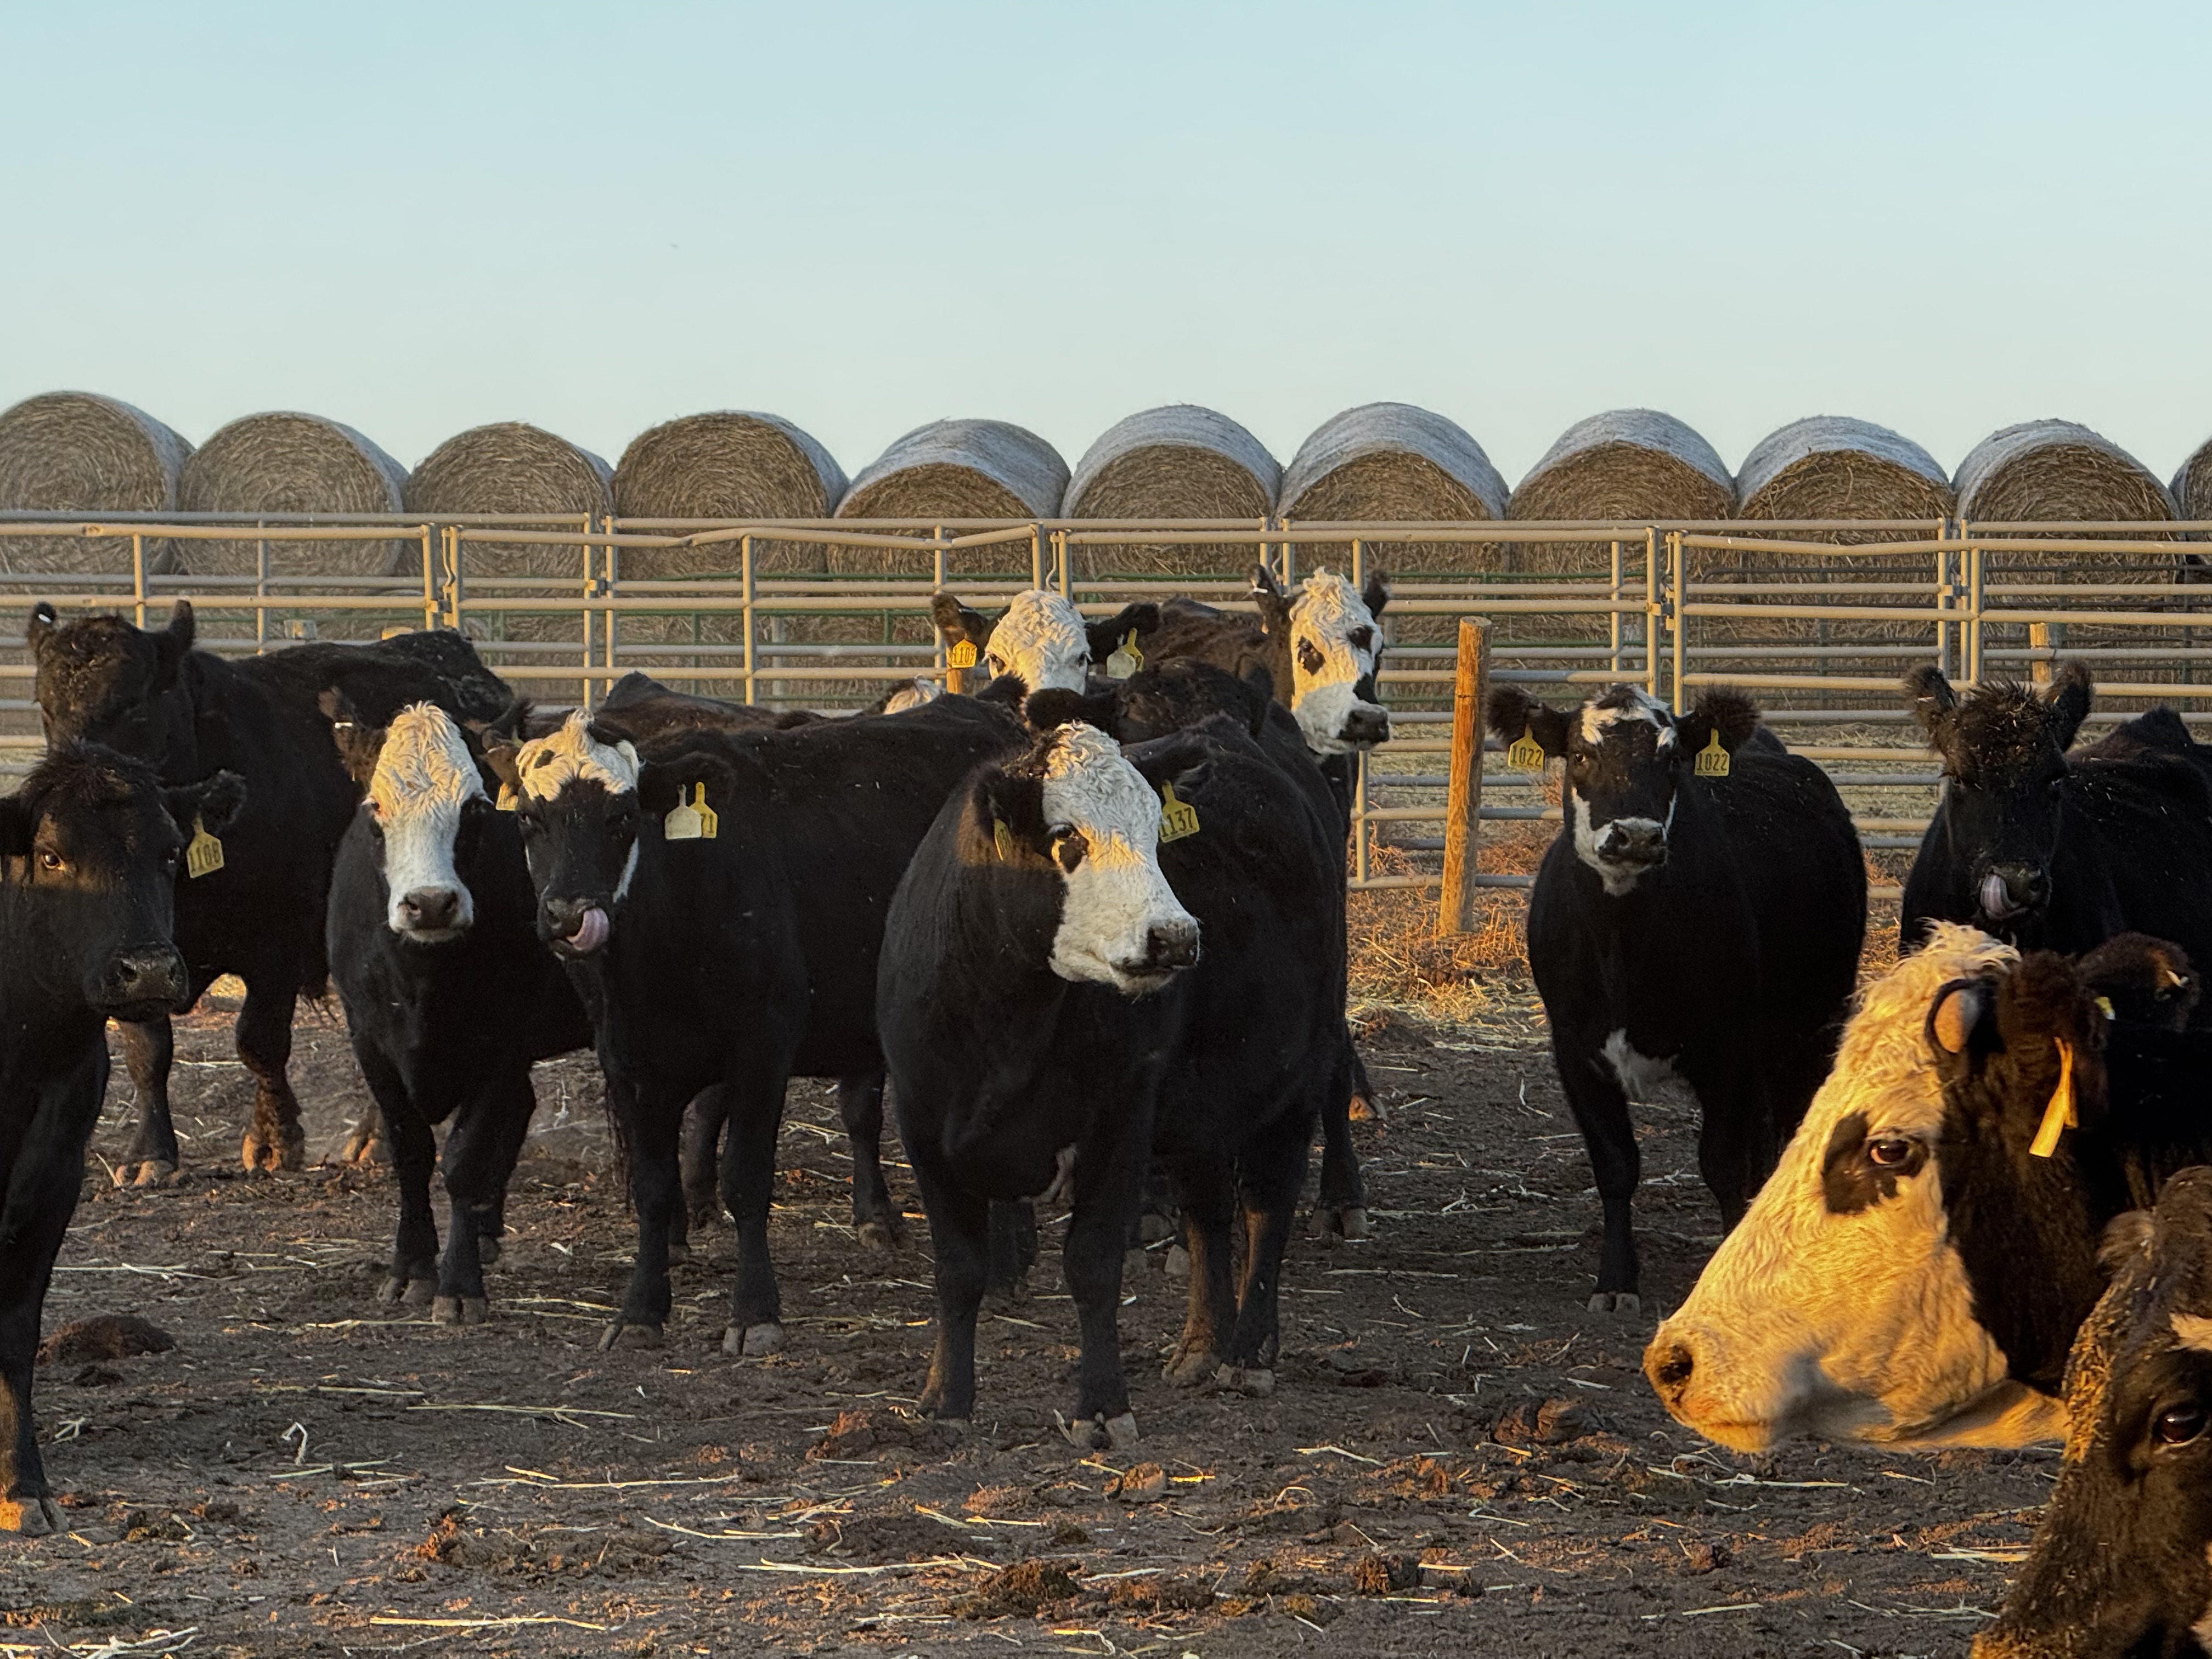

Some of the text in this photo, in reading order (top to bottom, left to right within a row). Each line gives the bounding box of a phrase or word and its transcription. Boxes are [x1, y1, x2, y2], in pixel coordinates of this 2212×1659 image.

[1510, 744, 1542, 767] 1022
[1696, 753, 1728, 771] 1022
[1160, 807, 1193, 837] 1137
[189, 841, 221, 872] 1108
